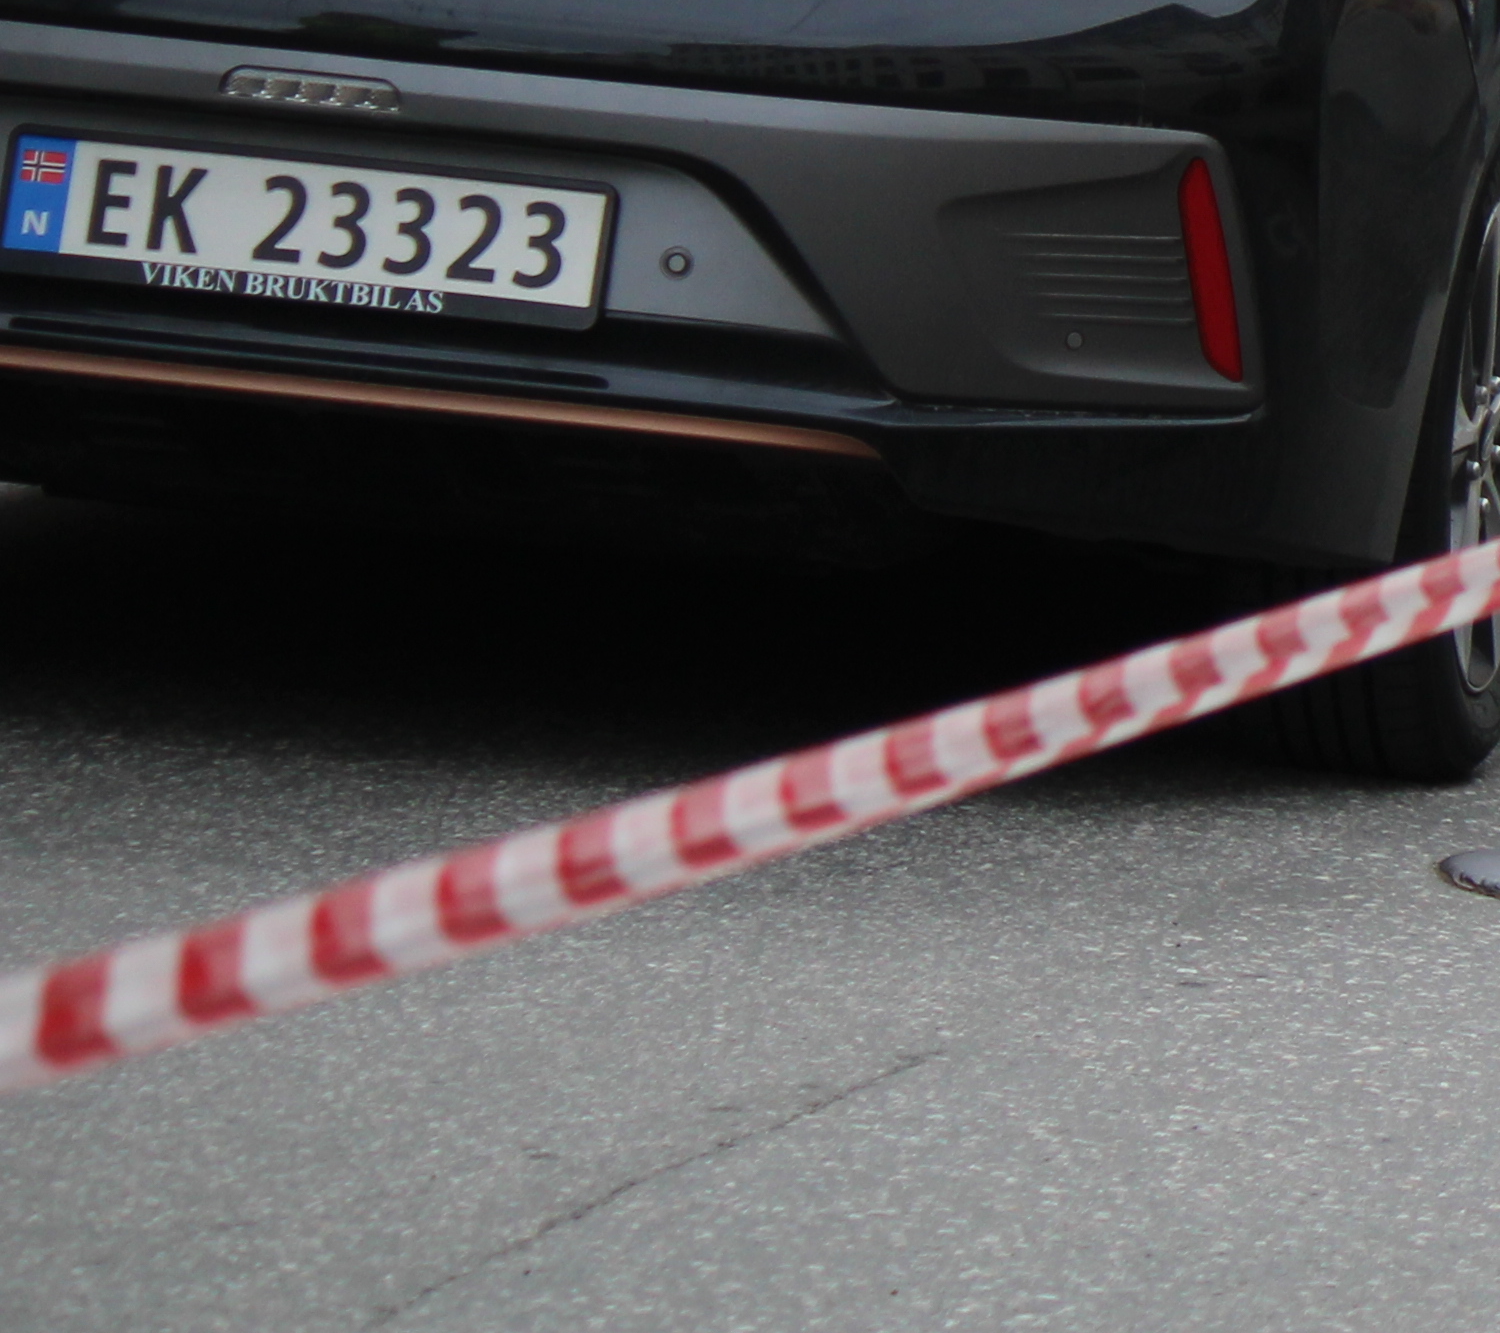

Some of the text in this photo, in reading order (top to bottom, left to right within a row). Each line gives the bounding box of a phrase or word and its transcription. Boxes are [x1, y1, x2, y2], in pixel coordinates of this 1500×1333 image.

[20, 209, 49, 236] N
[86, 159, 567, 289] EK 23323
[141, 261, 445, 314] VIKEN BRUKTBIL AS
